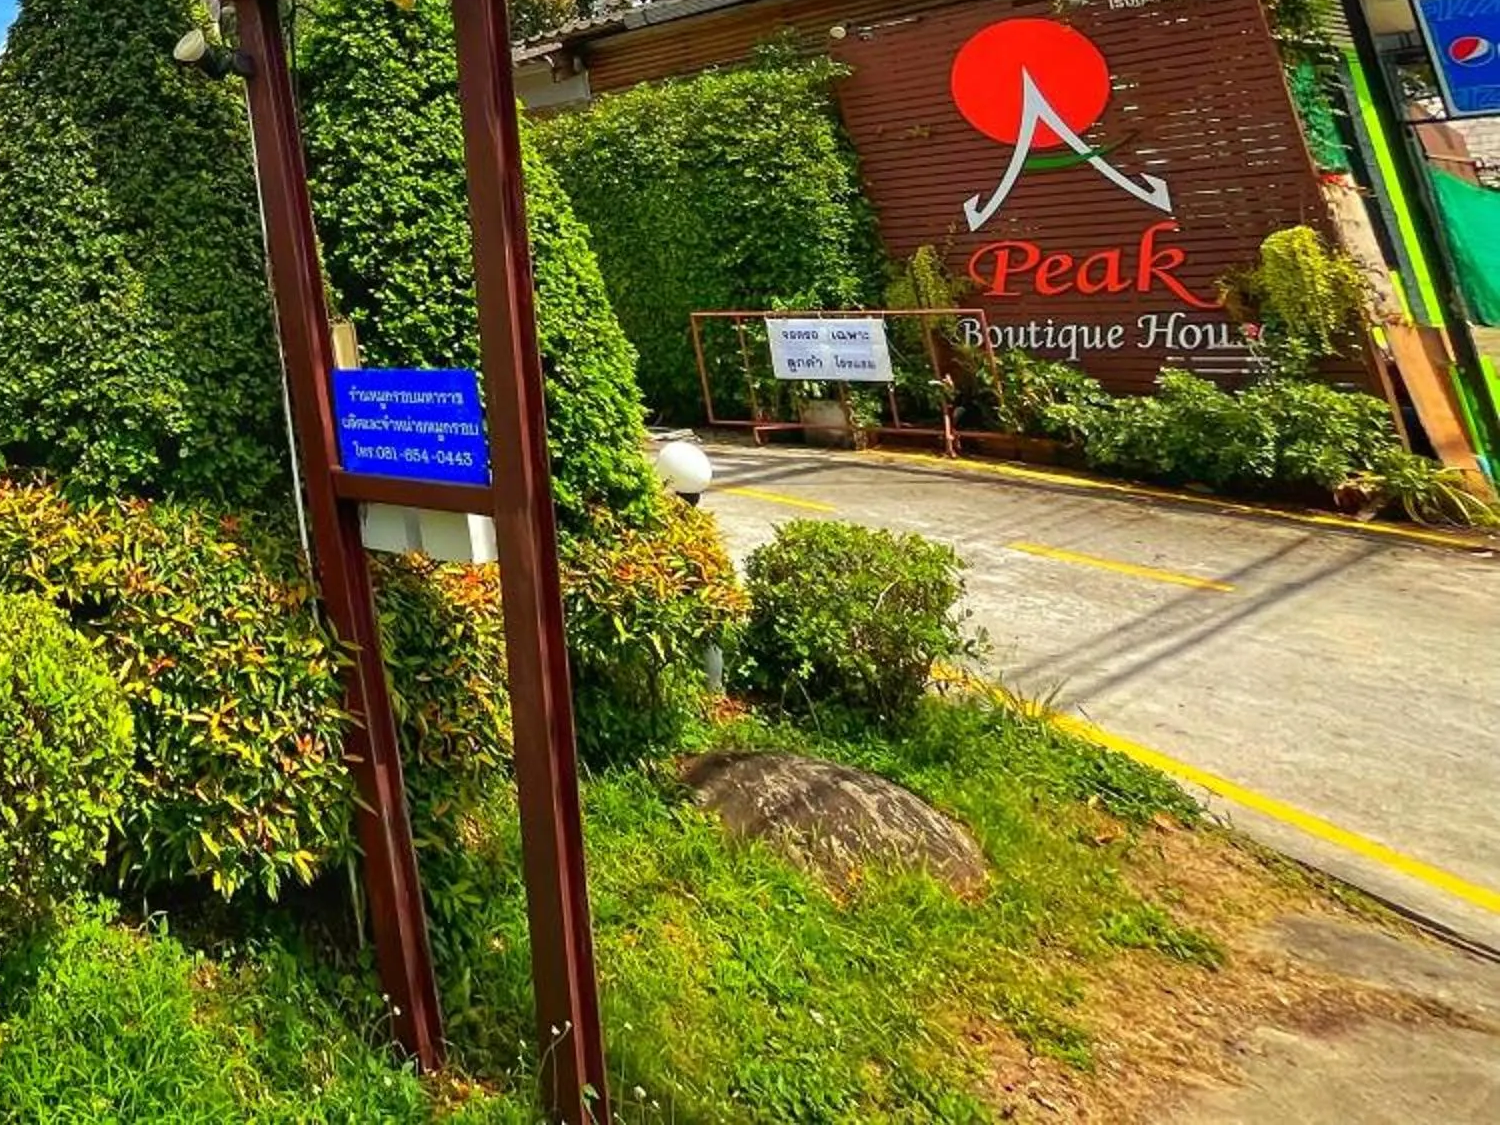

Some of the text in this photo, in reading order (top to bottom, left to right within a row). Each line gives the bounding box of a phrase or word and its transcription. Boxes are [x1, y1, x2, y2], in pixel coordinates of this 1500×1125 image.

[968, 221, 1225, 309] Peak
[959, 312, 1267, 362] Boutique Hou
